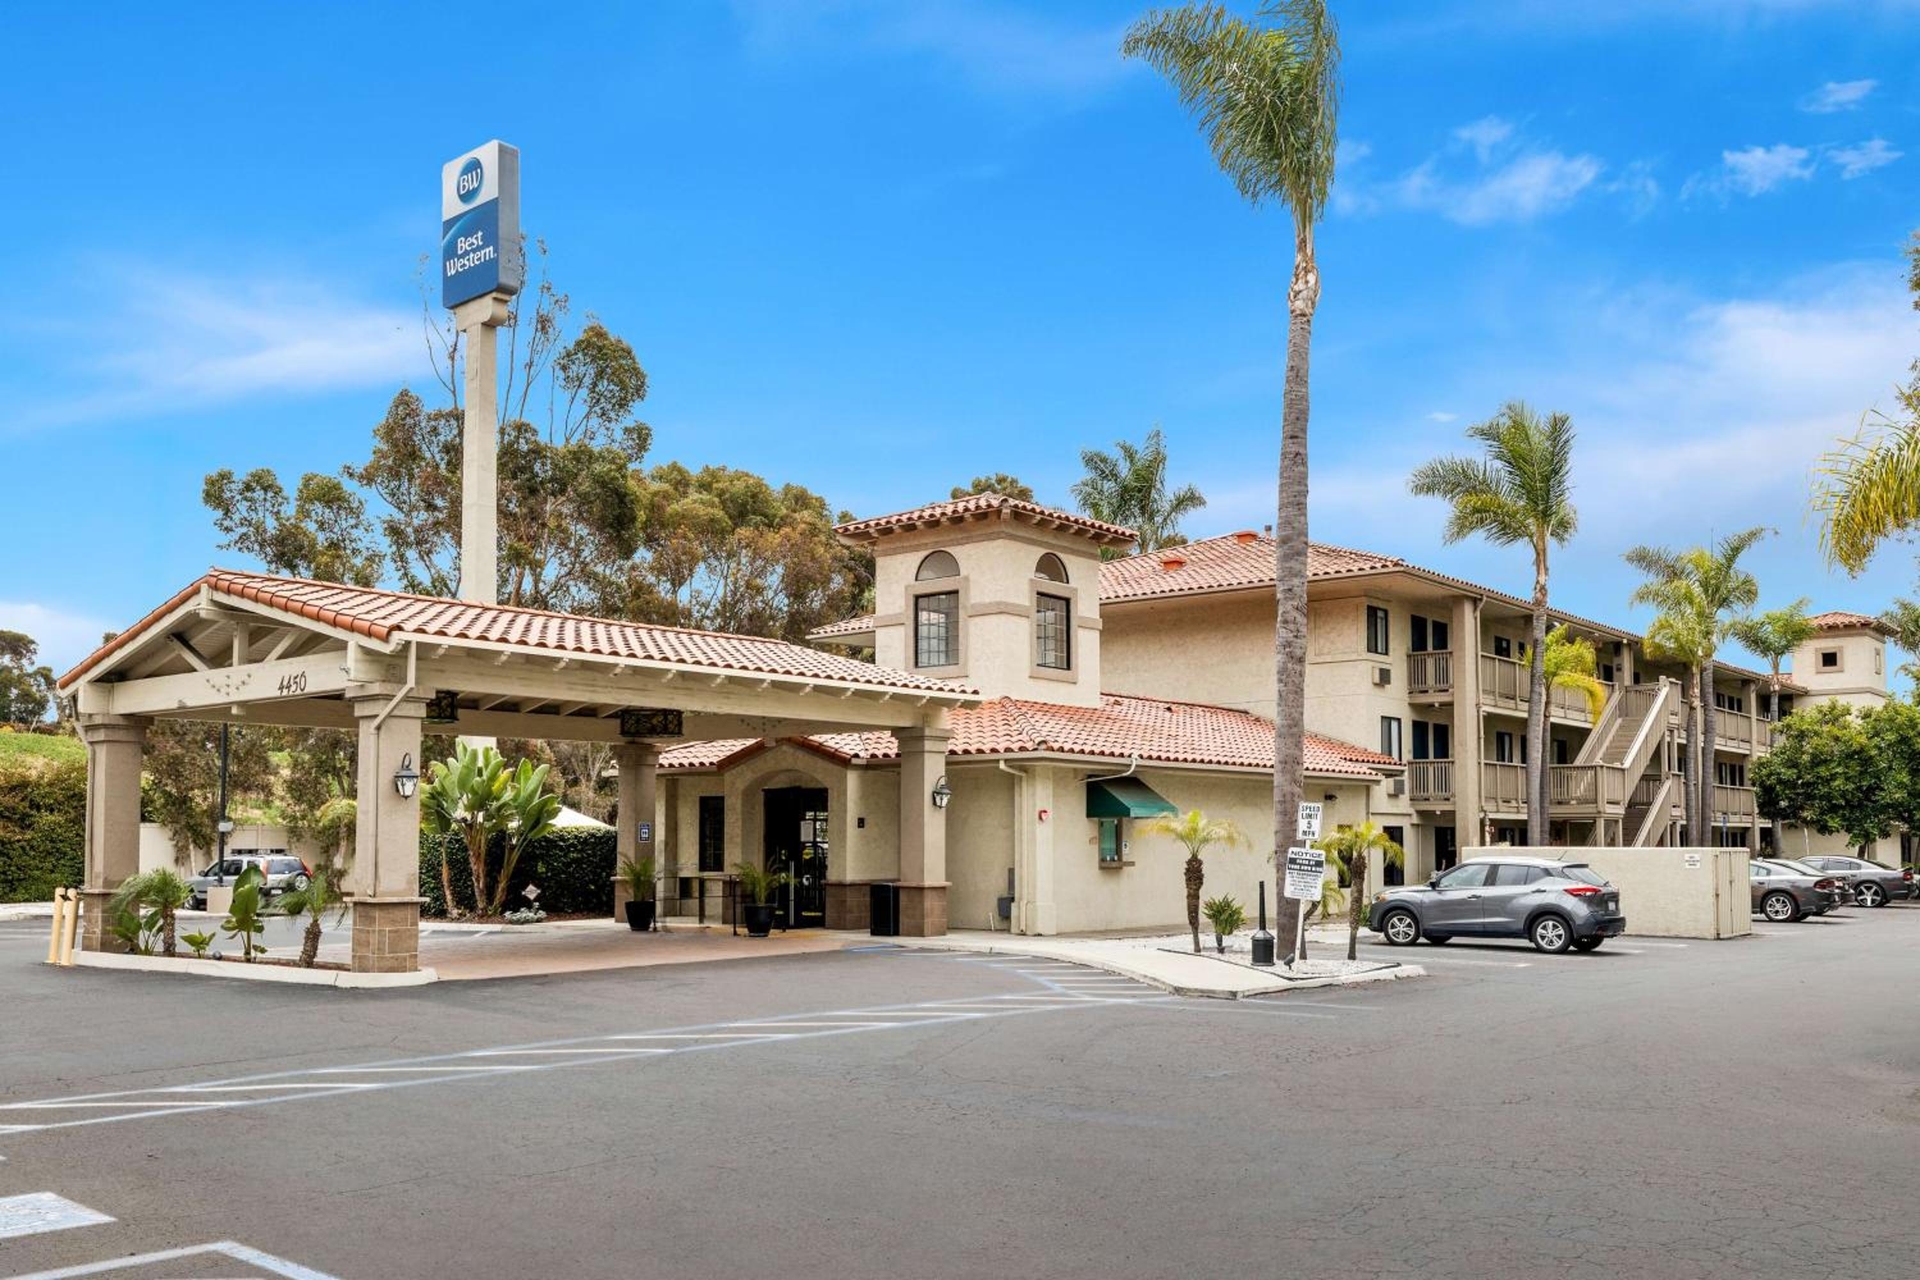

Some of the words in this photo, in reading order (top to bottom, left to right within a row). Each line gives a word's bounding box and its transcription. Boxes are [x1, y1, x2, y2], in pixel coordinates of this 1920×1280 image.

[460, 168, 481, 195] BW
[457, 230, 483, 255] Best
[277, 670, 307, 696] 4450
[1301, 804, 1320, 812] SPEED
[1301, 812, 1318, 820] LIMIT
[1306, 820, 1312, 829] 5
[1290, 850, 1323, 859] NOTICE
